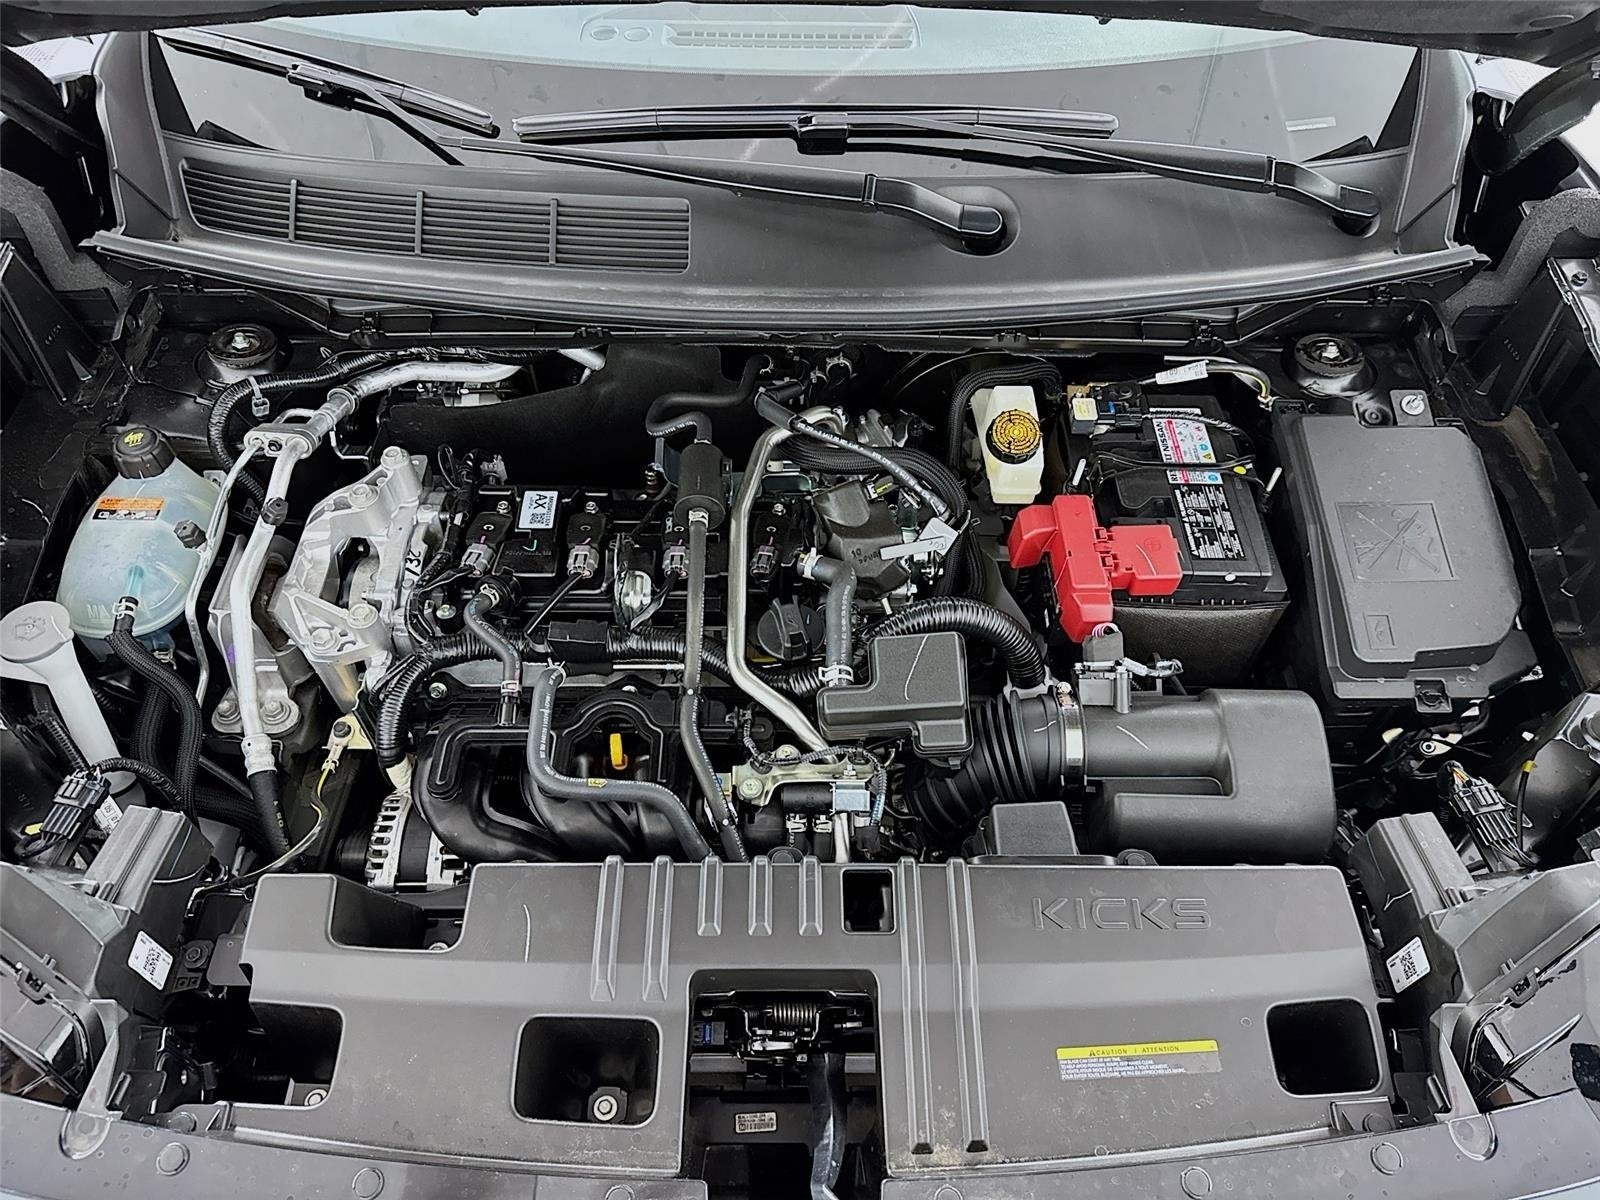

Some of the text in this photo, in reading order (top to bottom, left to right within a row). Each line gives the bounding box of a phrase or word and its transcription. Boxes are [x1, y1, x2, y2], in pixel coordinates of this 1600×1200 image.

[1156, 421, 1170, 452] NISSAN
[533, 493, 548, 509] AX
[1032, 897, 1212, 930] KICKS
[1096, 1048, 1128, 1056] CAUTION
